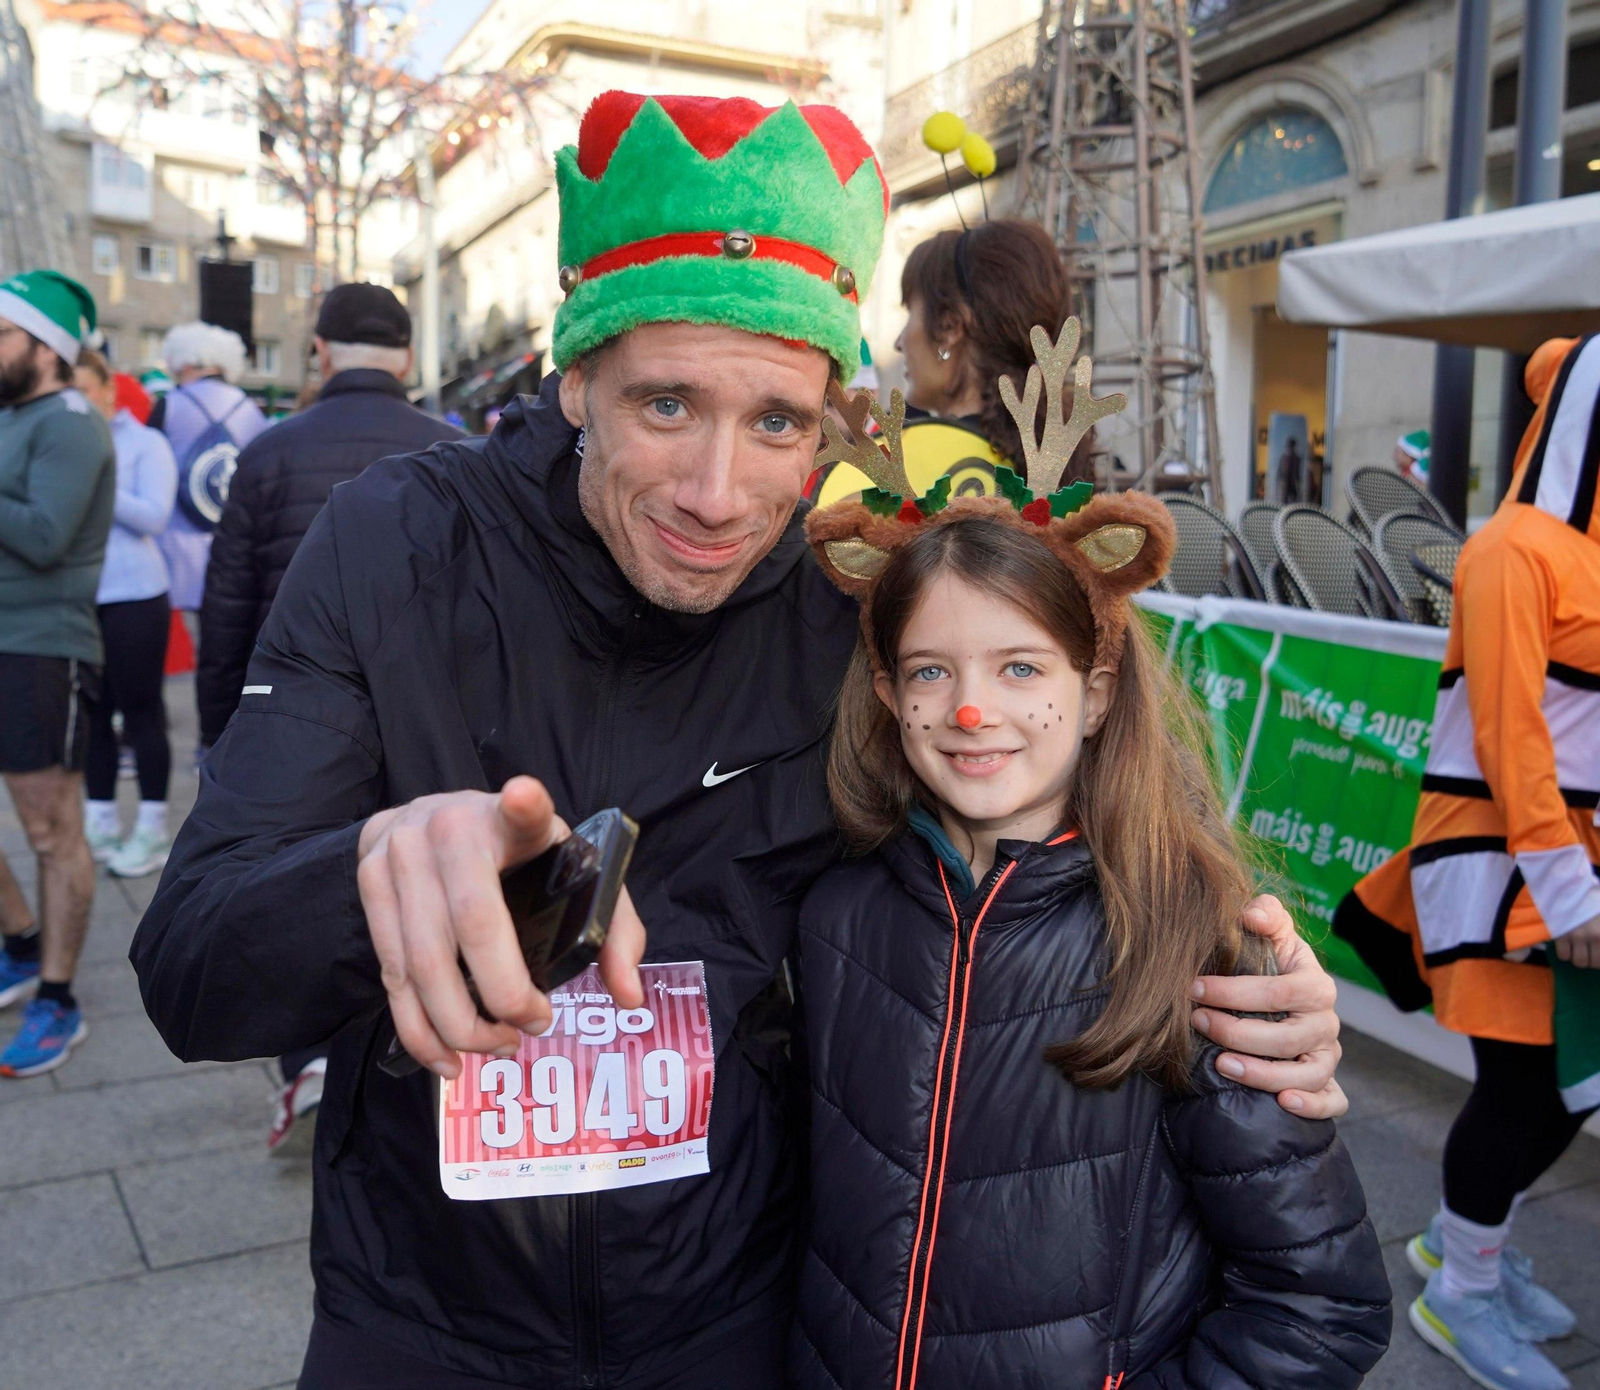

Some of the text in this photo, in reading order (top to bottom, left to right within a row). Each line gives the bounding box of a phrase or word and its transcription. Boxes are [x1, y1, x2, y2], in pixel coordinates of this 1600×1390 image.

[1280, 688, 1344, 730] máis
[1250, 807, 1314, 854] máis
[550, 993, 613, 1005] SILVEST
[480, 1049, 686, 1148] 3949
[619, 1157, 645, 1168] GADIS
[651, 1151, 676, 1162] avanza
